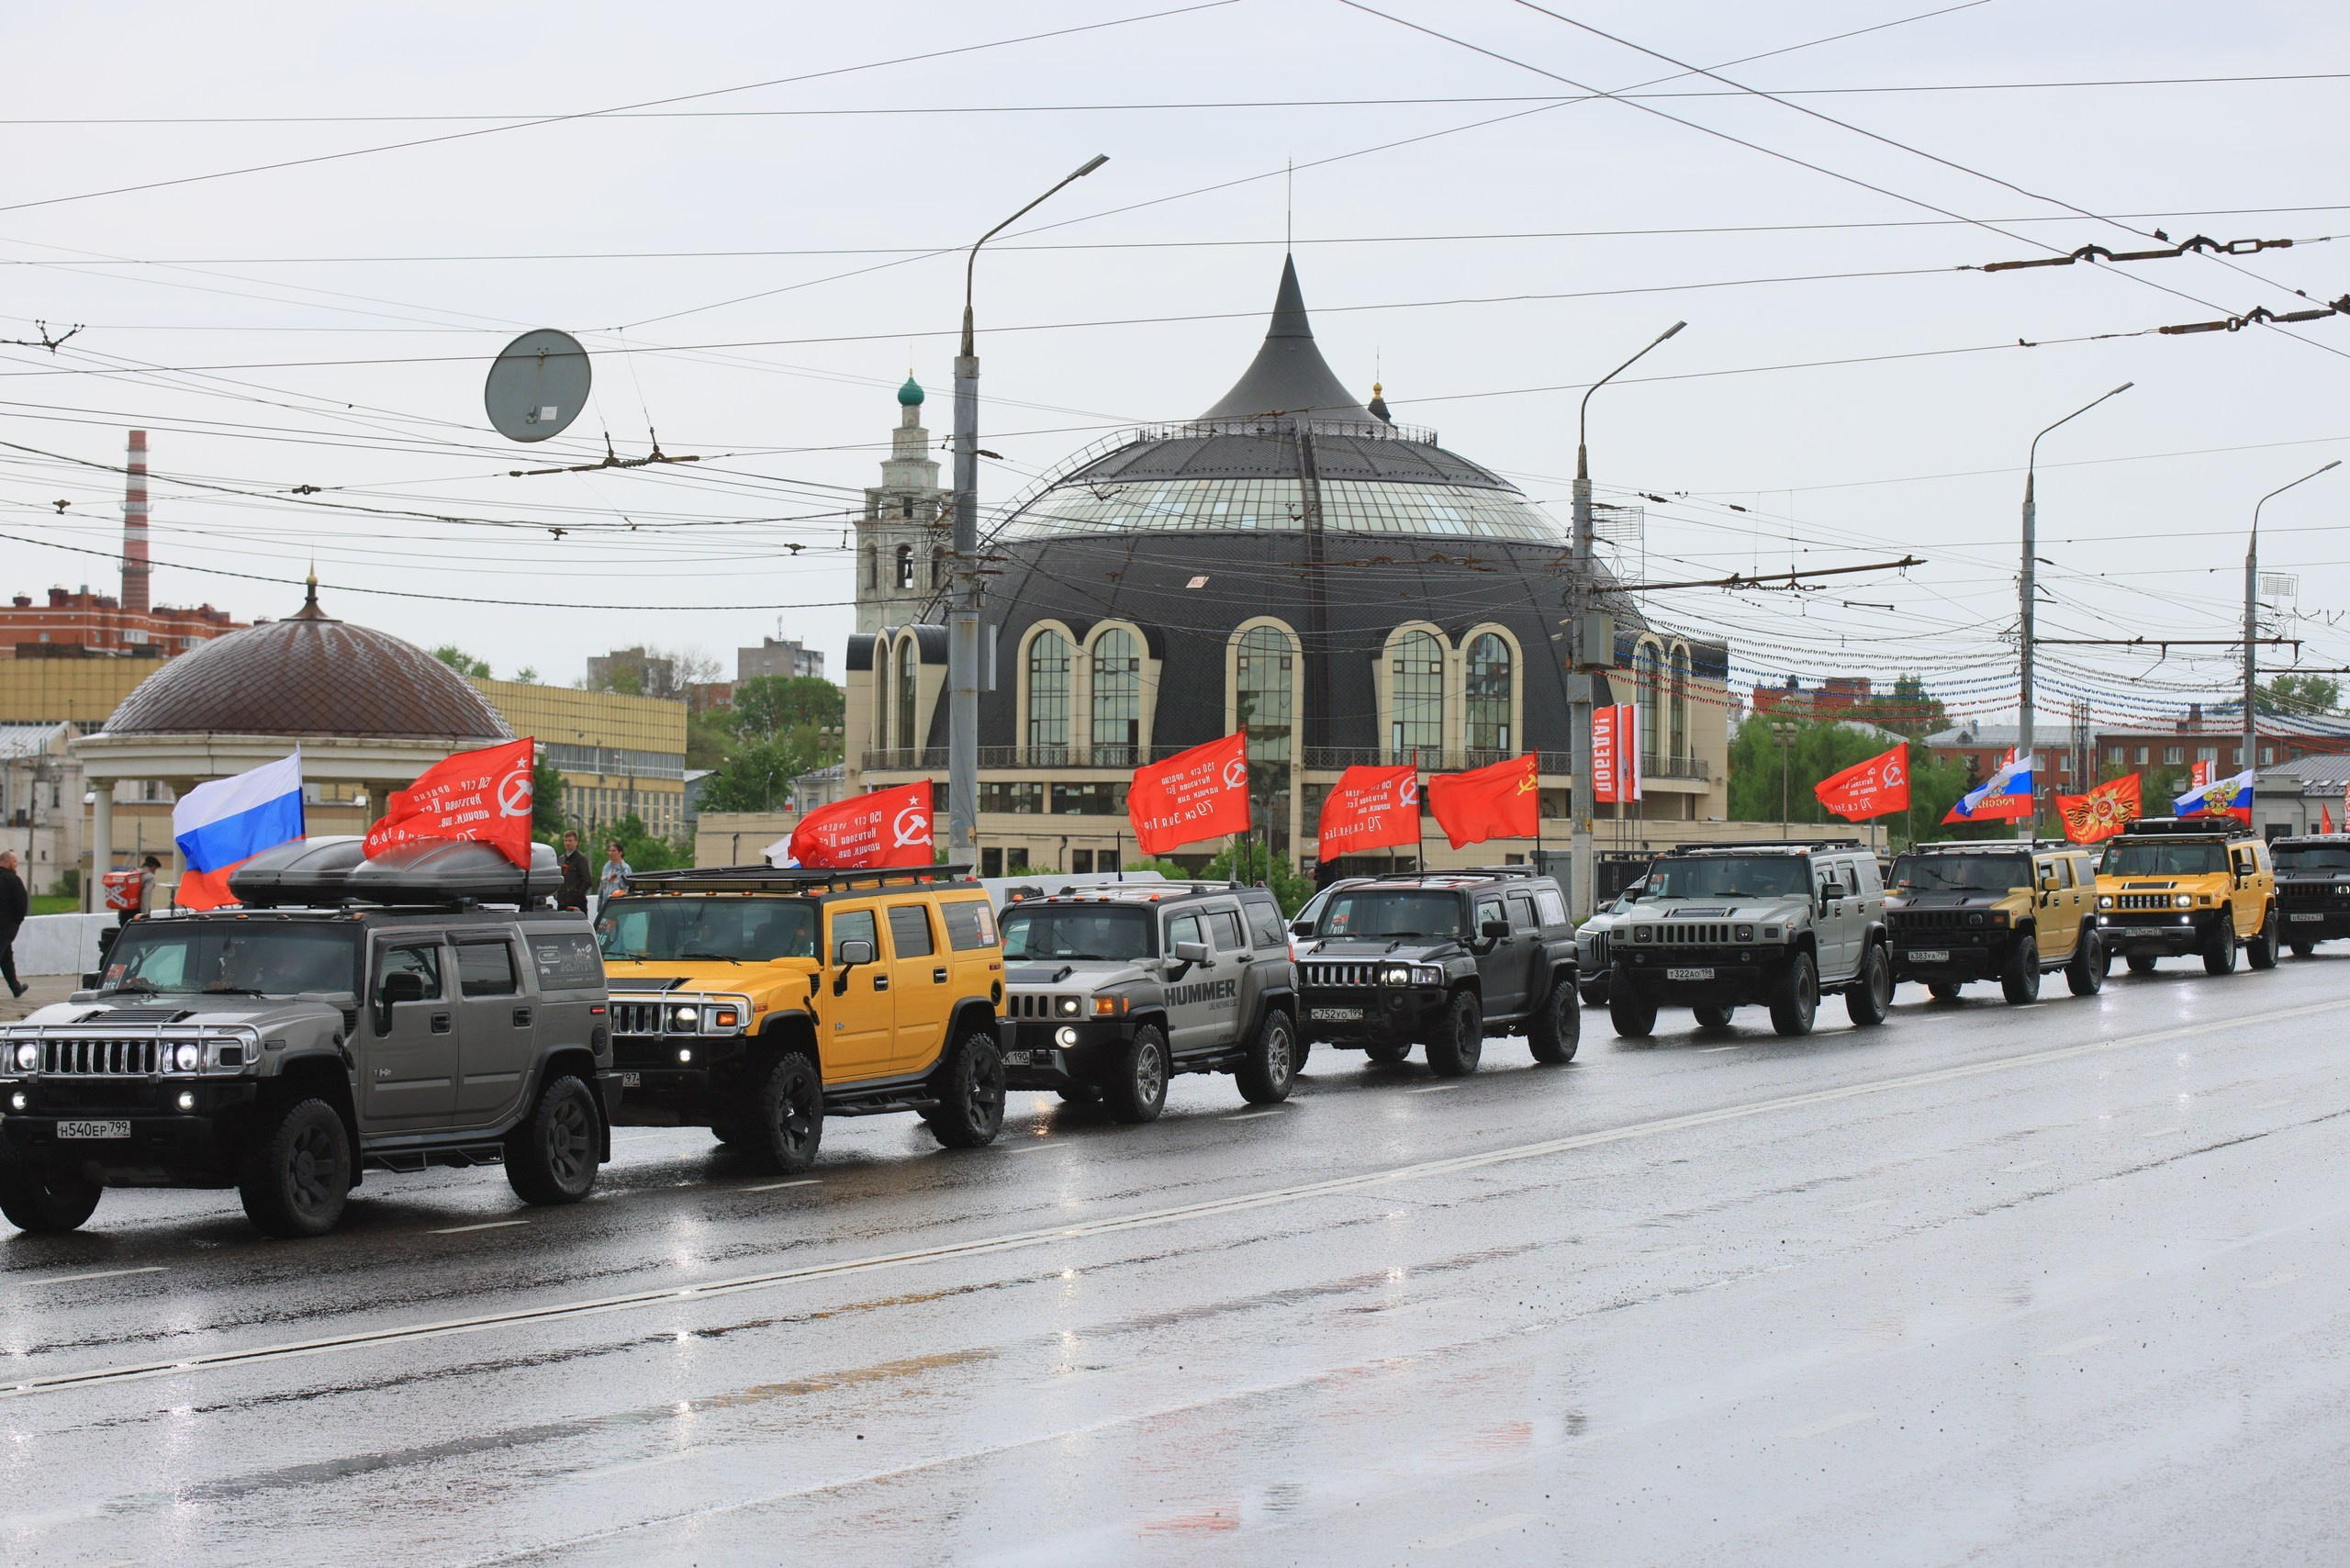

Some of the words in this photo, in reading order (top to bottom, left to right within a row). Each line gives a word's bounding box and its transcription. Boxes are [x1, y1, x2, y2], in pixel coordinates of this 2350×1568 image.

[1164, 979, 1237, 1007] HUMMER
[1013, 1052, 1027, 1060] 190
[109, 1122, 128, 1133] 799
